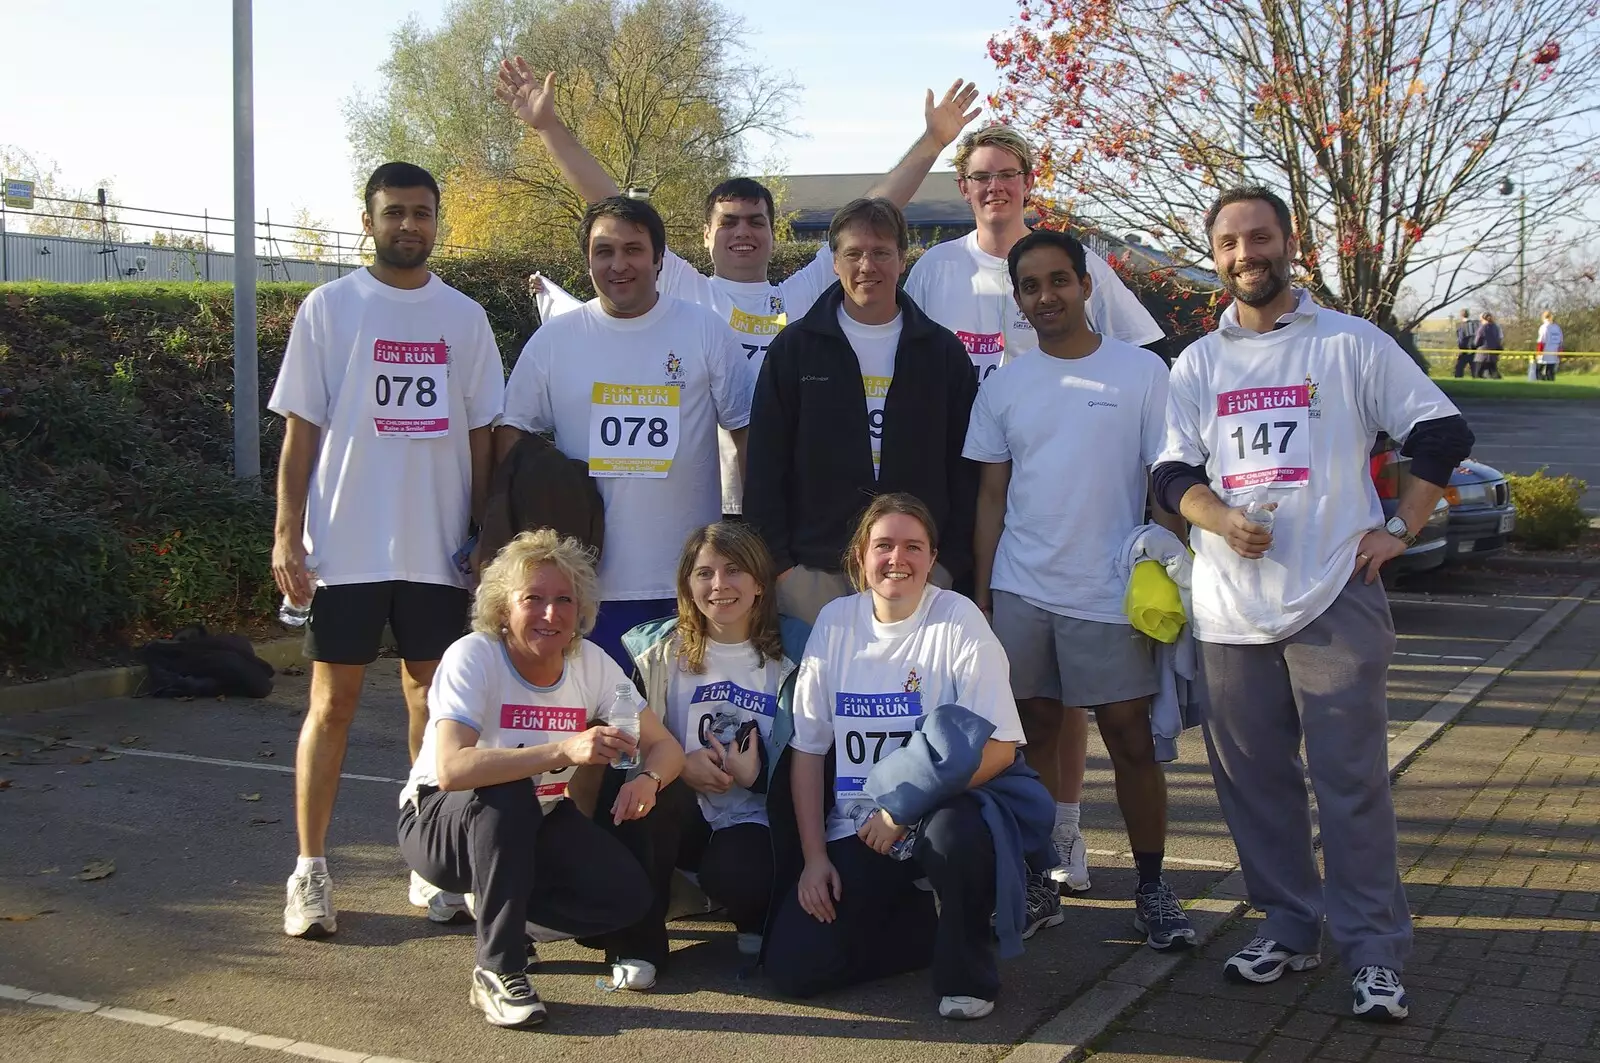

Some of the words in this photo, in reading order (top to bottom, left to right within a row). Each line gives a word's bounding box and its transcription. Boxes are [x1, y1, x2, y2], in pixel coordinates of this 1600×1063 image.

[753, 324, 780, 334] RUN
[378, 344, 435, 352] CAMBRIDGE
[979, 343, 1000, 353] RUN
[377, 350, 400, 361] FUN
[405, 352, 436, 363] RUN
[376, 375, 438, 407] 078
[603, 385, 668, 395] CAMBRIDGE
[1228, 389, 1297, 402] CAMBRIDGE
[602, 393, 633, 404] FUN
[638, 394, 669, 405] RUN
[1228, 398, 1258, 413] FUN
[1263, 395, 1297, 409] RUN
[600, 416, 669, 447] 078
[1231, 421, 1298, 460] 147
[705, 684, 767, 702] CAMBRIDGE
[701, 689, 731, 701] FUN
[733, 694, 767, 713] RUN
[513, 709, 577, 718] CAMBRIDGE
[844, 703, 871, 716] FUN
[875, 703, 909, 716] RUN
[512, 716, 543, 729] FUN
[547, 718, 577, 730] RUN
[846, 730, 913, 765] 077
